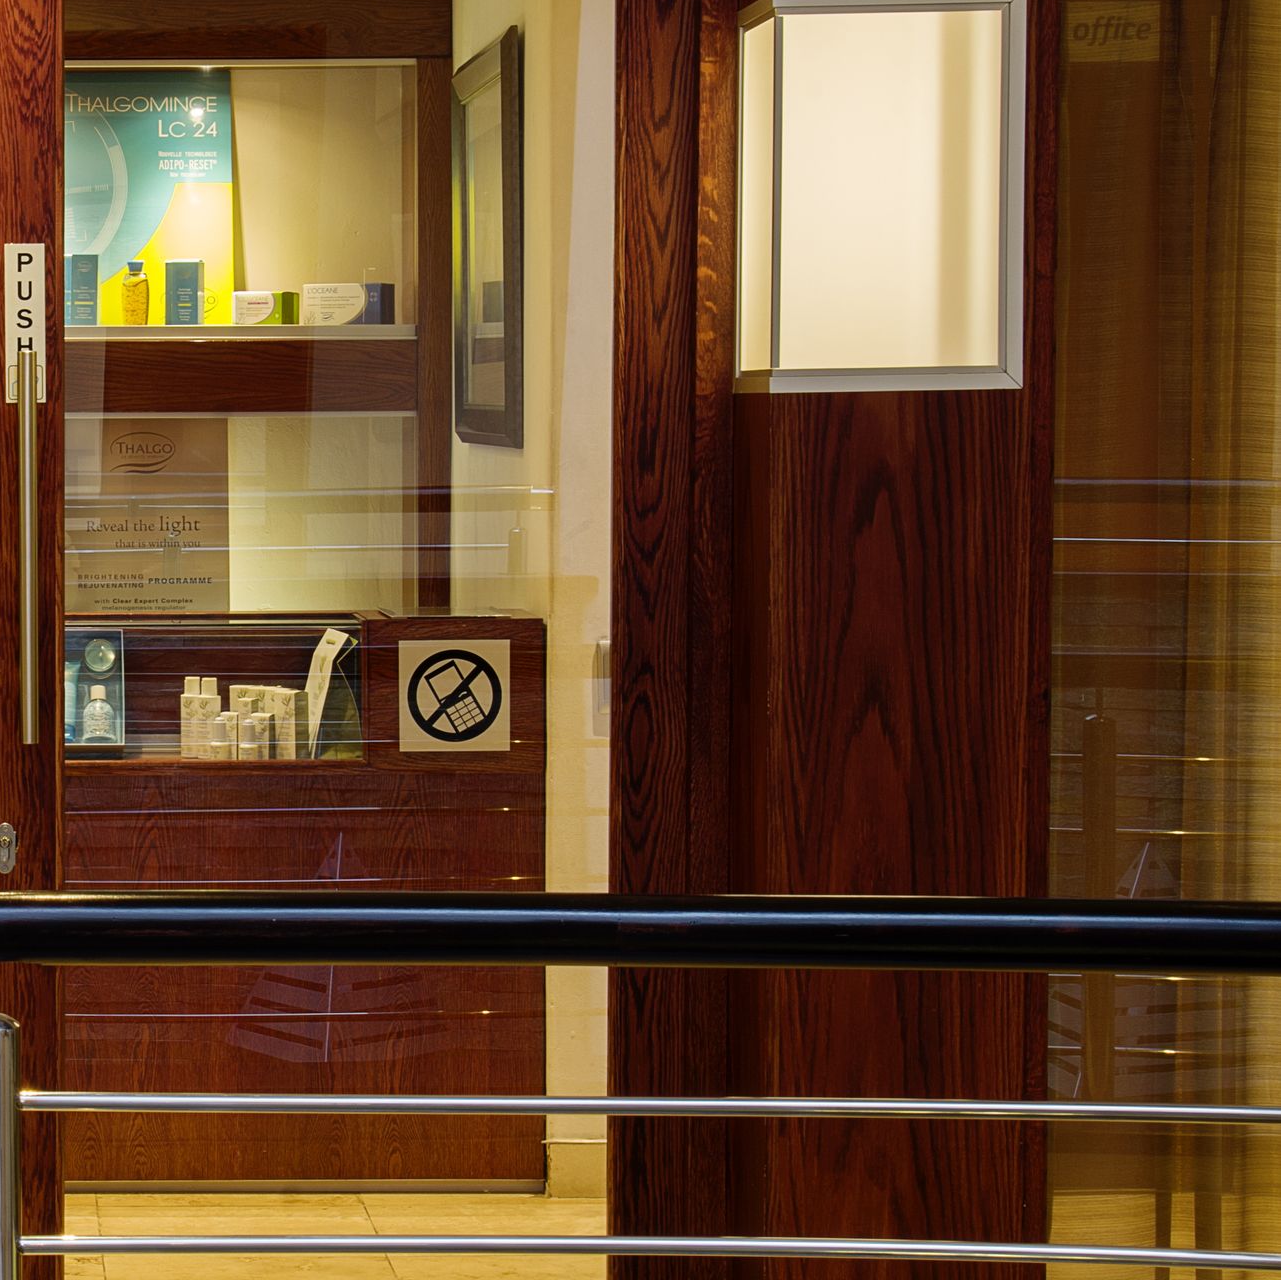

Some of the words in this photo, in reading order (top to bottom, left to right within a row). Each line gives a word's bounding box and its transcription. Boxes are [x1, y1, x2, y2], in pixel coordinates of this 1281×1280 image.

[1072, 15, 1152, 46] office
[65, 93, 218, 113] THALGOMINCE
[157, 119, 186, 138] LC
[192, 121, 218, 138] 24
[307, 287, 338, 295] L'OCEANE
[16, 252, 34, 352] PUSH
[116, 441, 173, 454] THALGO
[86, 519, 129, 533] Reveal
[133, 519, 155, 532] the
[159, 515, 201, 537] light
[115, 539, 135, 548] that
[138, 538, 146, 548] is
[147, 537, 180, 548] within
[183, 539, 201, 550] you
[77, 573, 144, 581] BRIGHTENING
[148, 576, 213, 585] PROGRAMME
[134, 597, 159, 606] Expert
[161, 597, 194, 606] Complex
